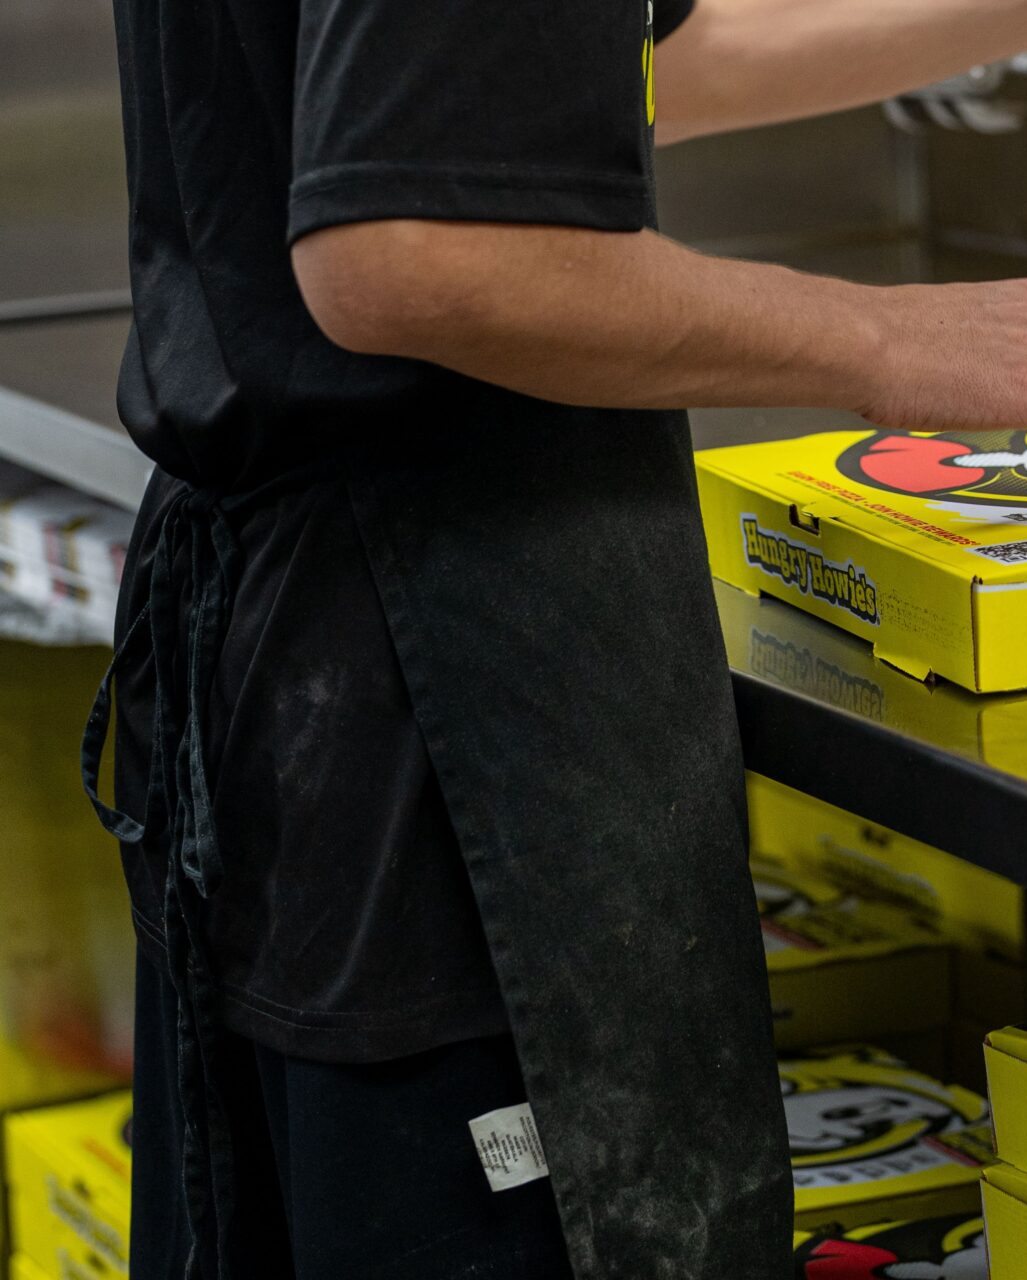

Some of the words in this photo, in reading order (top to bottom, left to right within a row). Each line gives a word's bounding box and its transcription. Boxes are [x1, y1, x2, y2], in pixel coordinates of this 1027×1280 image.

[890, 511, 928, 527] HOWIE
[743, 519, 808, 593] Hungry
[808, 553, 878, 625] Howie's
